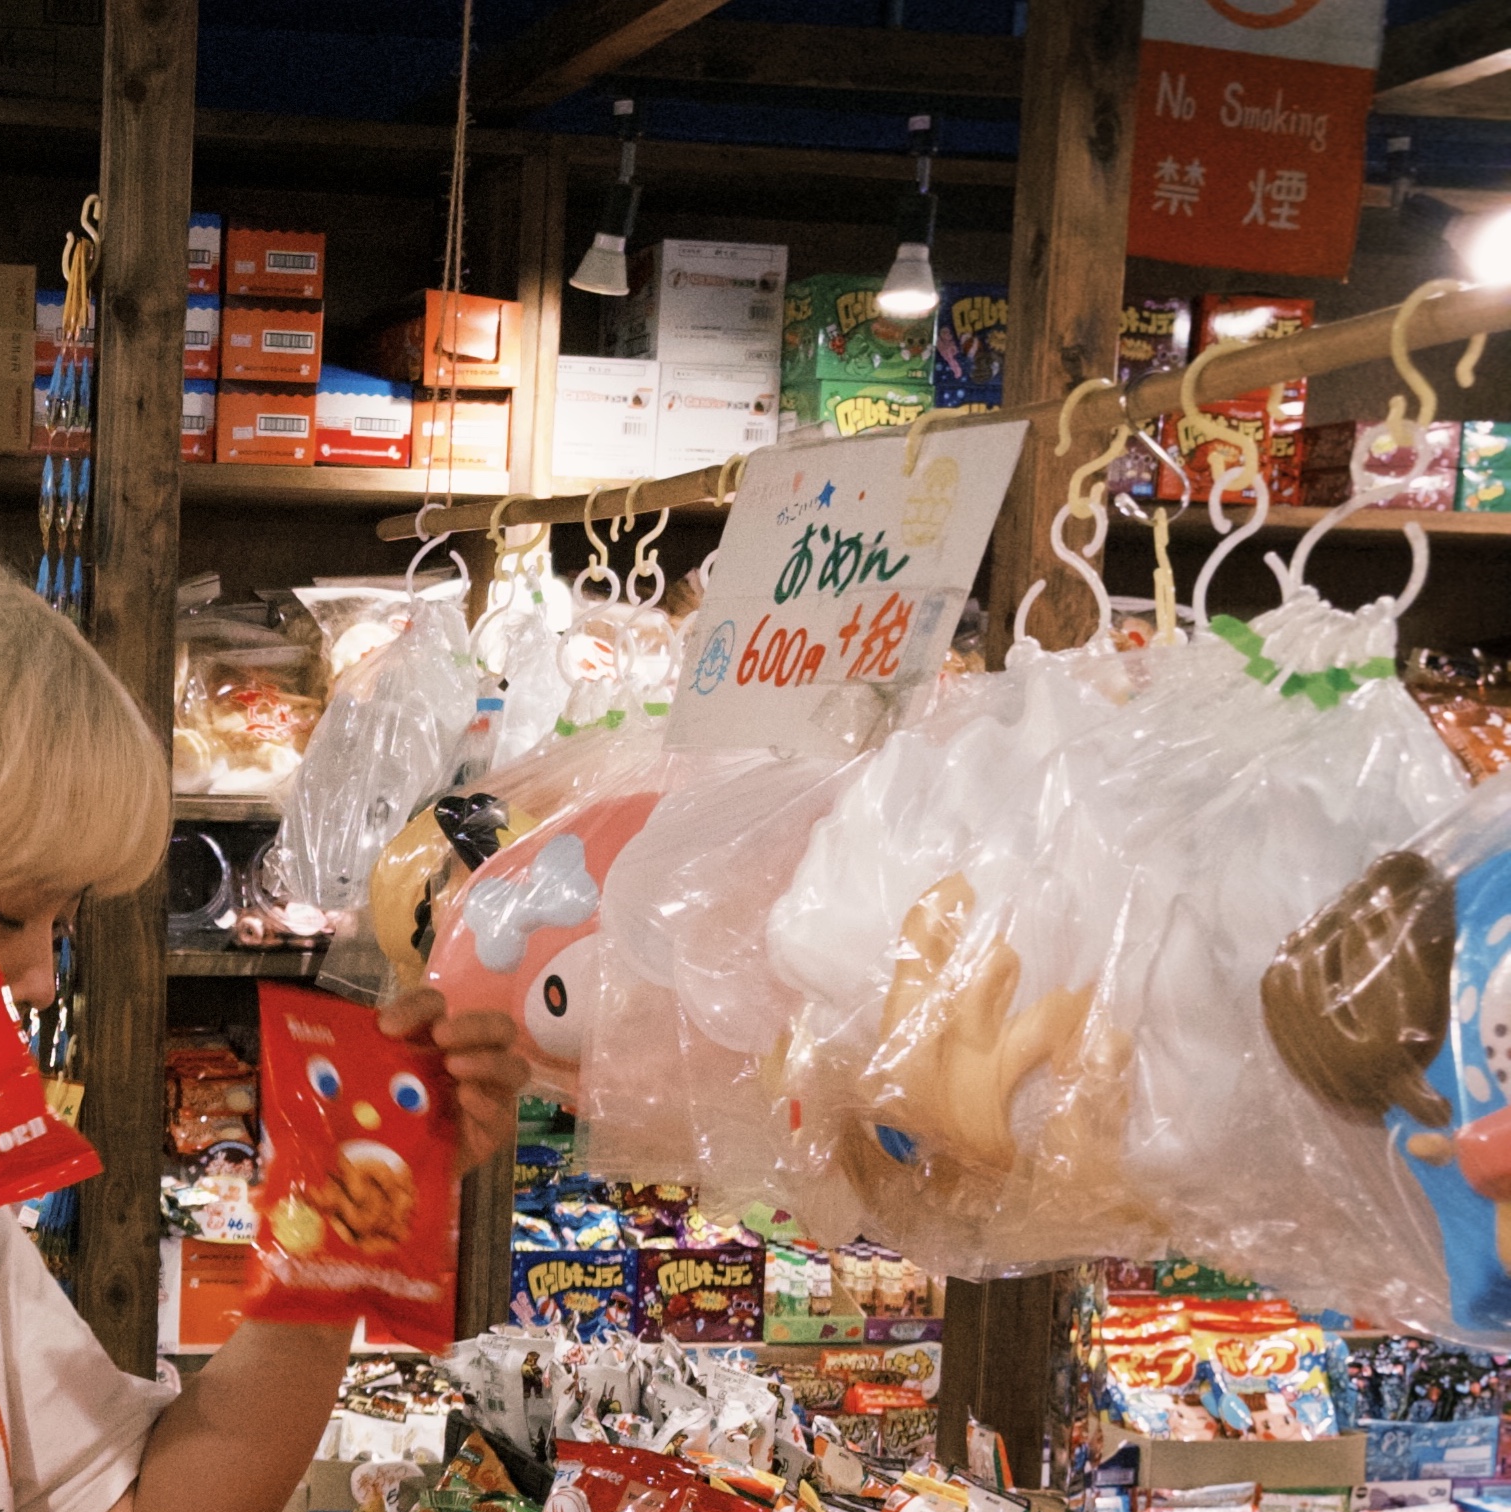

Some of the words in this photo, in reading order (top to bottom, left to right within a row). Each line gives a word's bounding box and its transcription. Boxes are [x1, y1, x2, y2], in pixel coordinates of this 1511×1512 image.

[1154, 70, 1195, 120] No
[1219, 82, 1330, 153] Smoking
[1150, 153, 1308, 231] 禁煙
[774, 523, 910, 604] おめん
